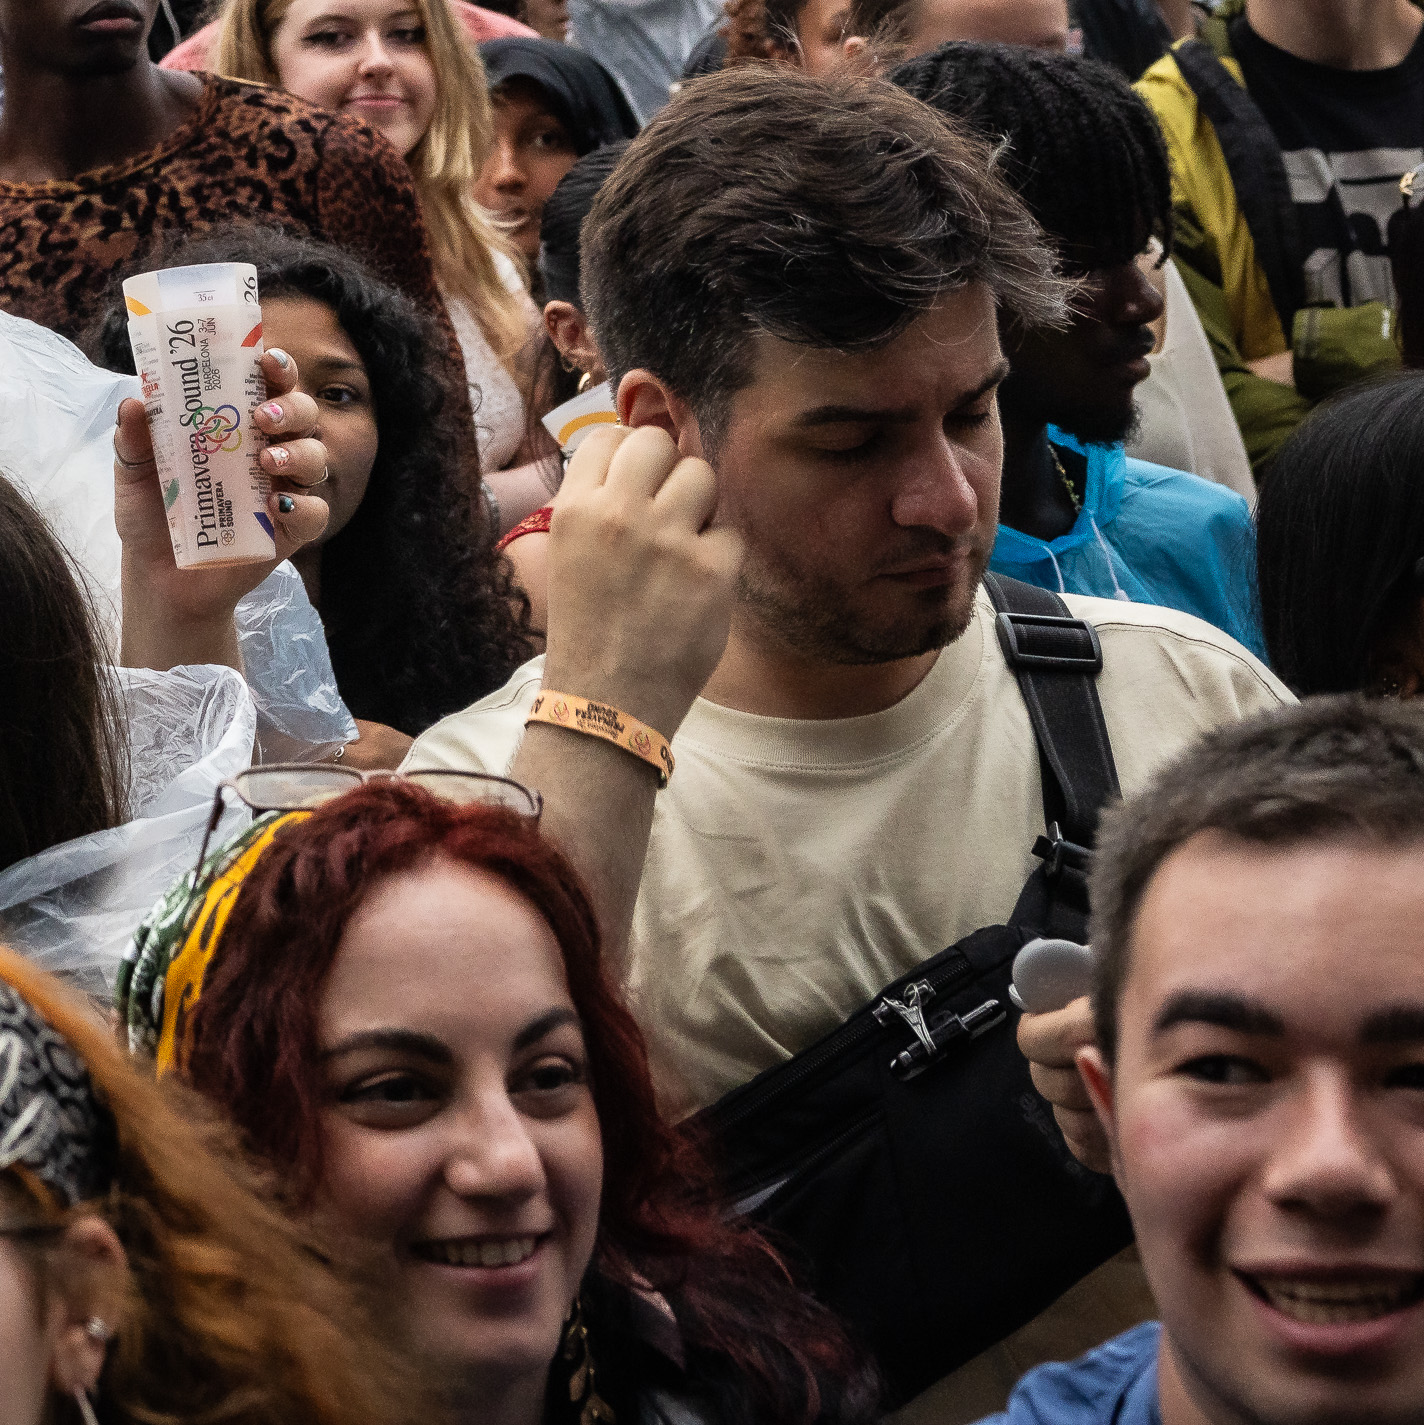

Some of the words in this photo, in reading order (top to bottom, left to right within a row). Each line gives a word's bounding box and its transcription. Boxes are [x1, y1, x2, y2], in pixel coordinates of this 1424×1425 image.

[207, 317, 217, 336] JUN
[200, 338, 213, 391] BARCELONA
[213, 368, 222, 390] 2026
[172, 357, 205, 427] Sound
[189, 433, 219, 551] Primavera
[216, 481, 227, 527] PRIMAVERA
[225, 499, 234, 527] SOUND
